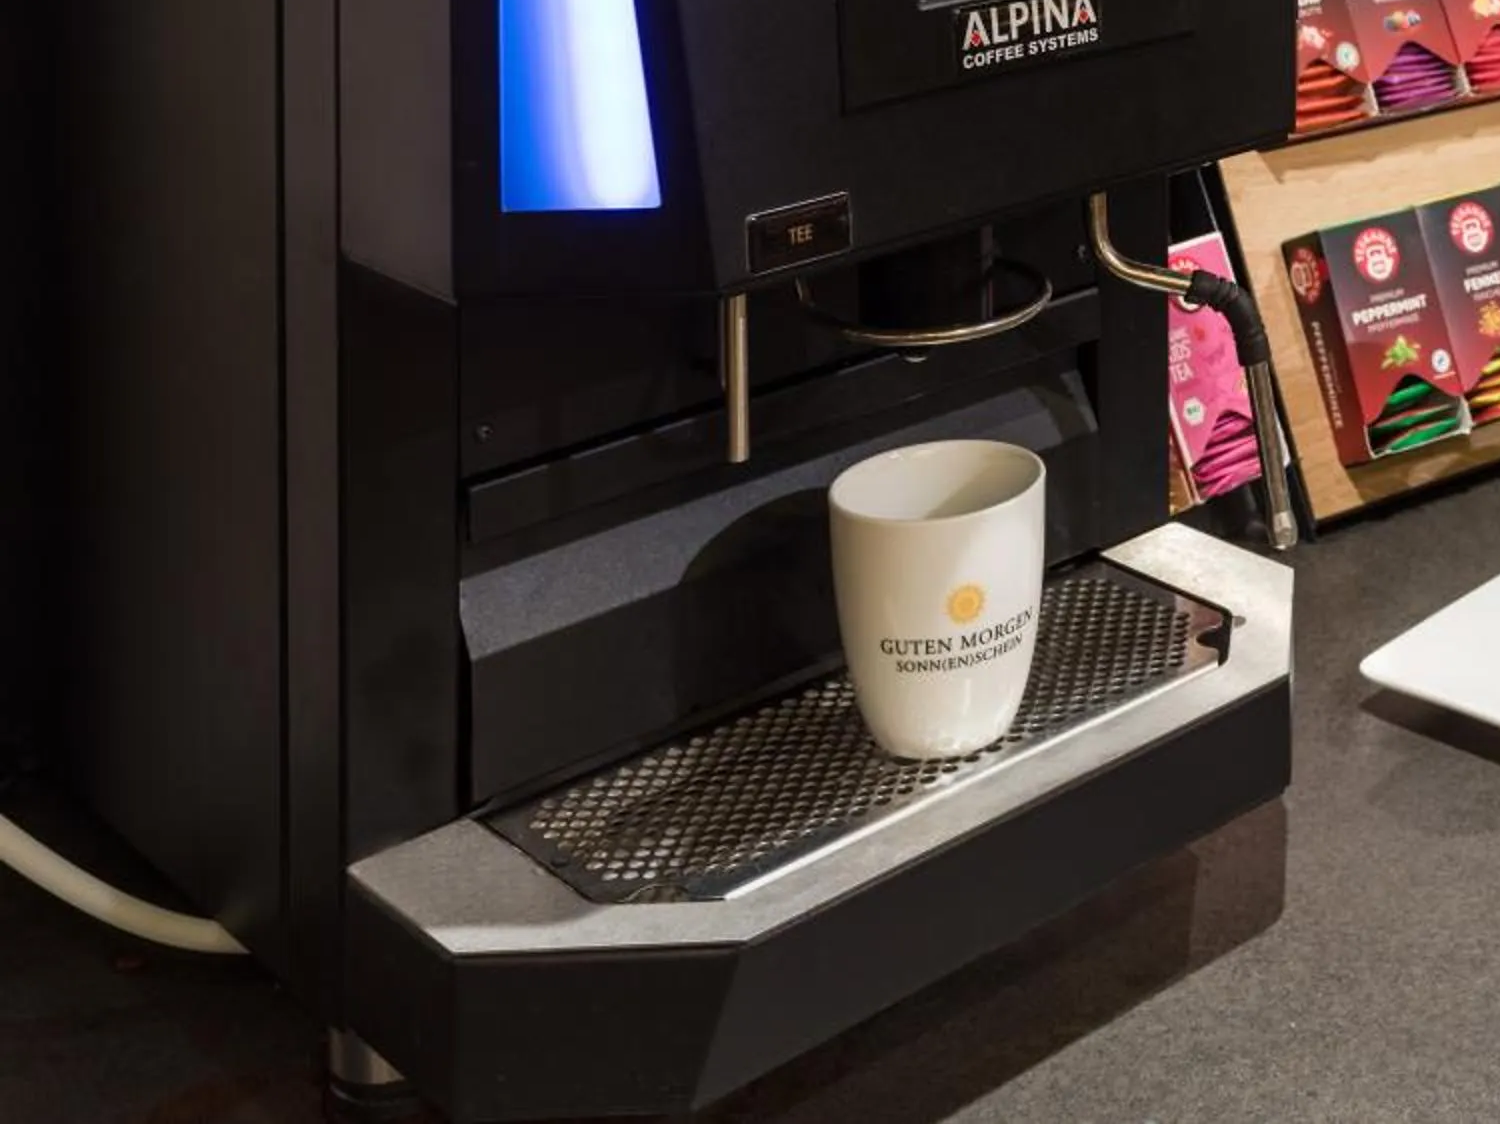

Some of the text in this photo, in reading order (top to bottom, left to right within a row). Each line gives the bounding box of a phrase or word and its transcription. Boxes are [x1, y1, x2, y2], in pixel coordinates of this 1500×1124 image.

[963, 28, 1099, 69] COFFEE SYSTEMS
[788, 223, 815, 245] TEE
[1352, 294, 1427, 326] PEPPERMINT
[880, 605, 1034, 656] GUTEN MORGEN
[896, 633, 1024, 673] SONN(EN)SCHEIN
